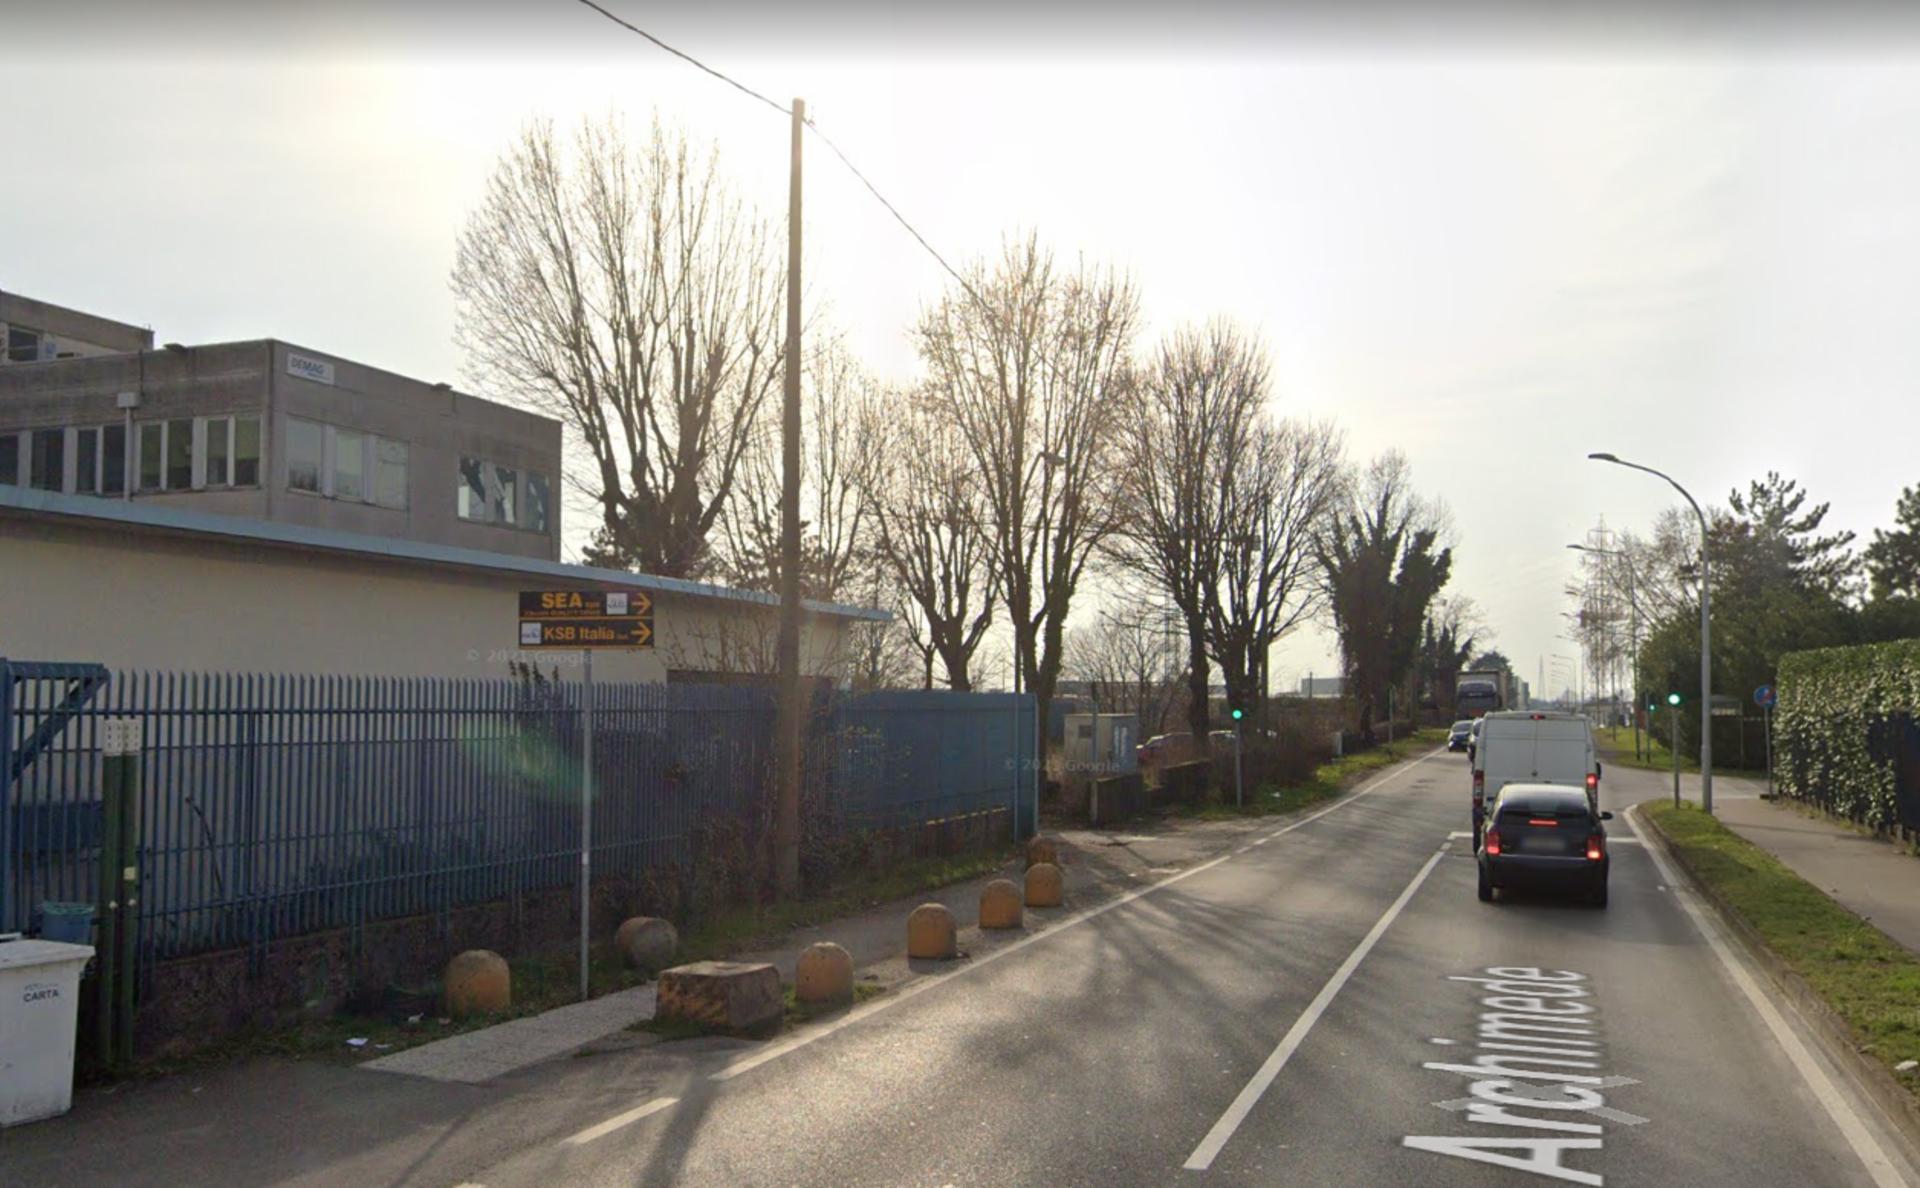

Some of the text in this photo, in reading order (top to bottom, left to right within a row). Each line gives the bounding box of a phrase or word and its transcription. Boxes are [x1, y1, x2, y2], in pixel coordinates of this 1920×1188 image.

[541, 592, 583, 608] SEA
[544, 626, 575, 640] KSB
[579, 626, 615, 640] Italia
[23, 989, 59, 1002] CARTA
